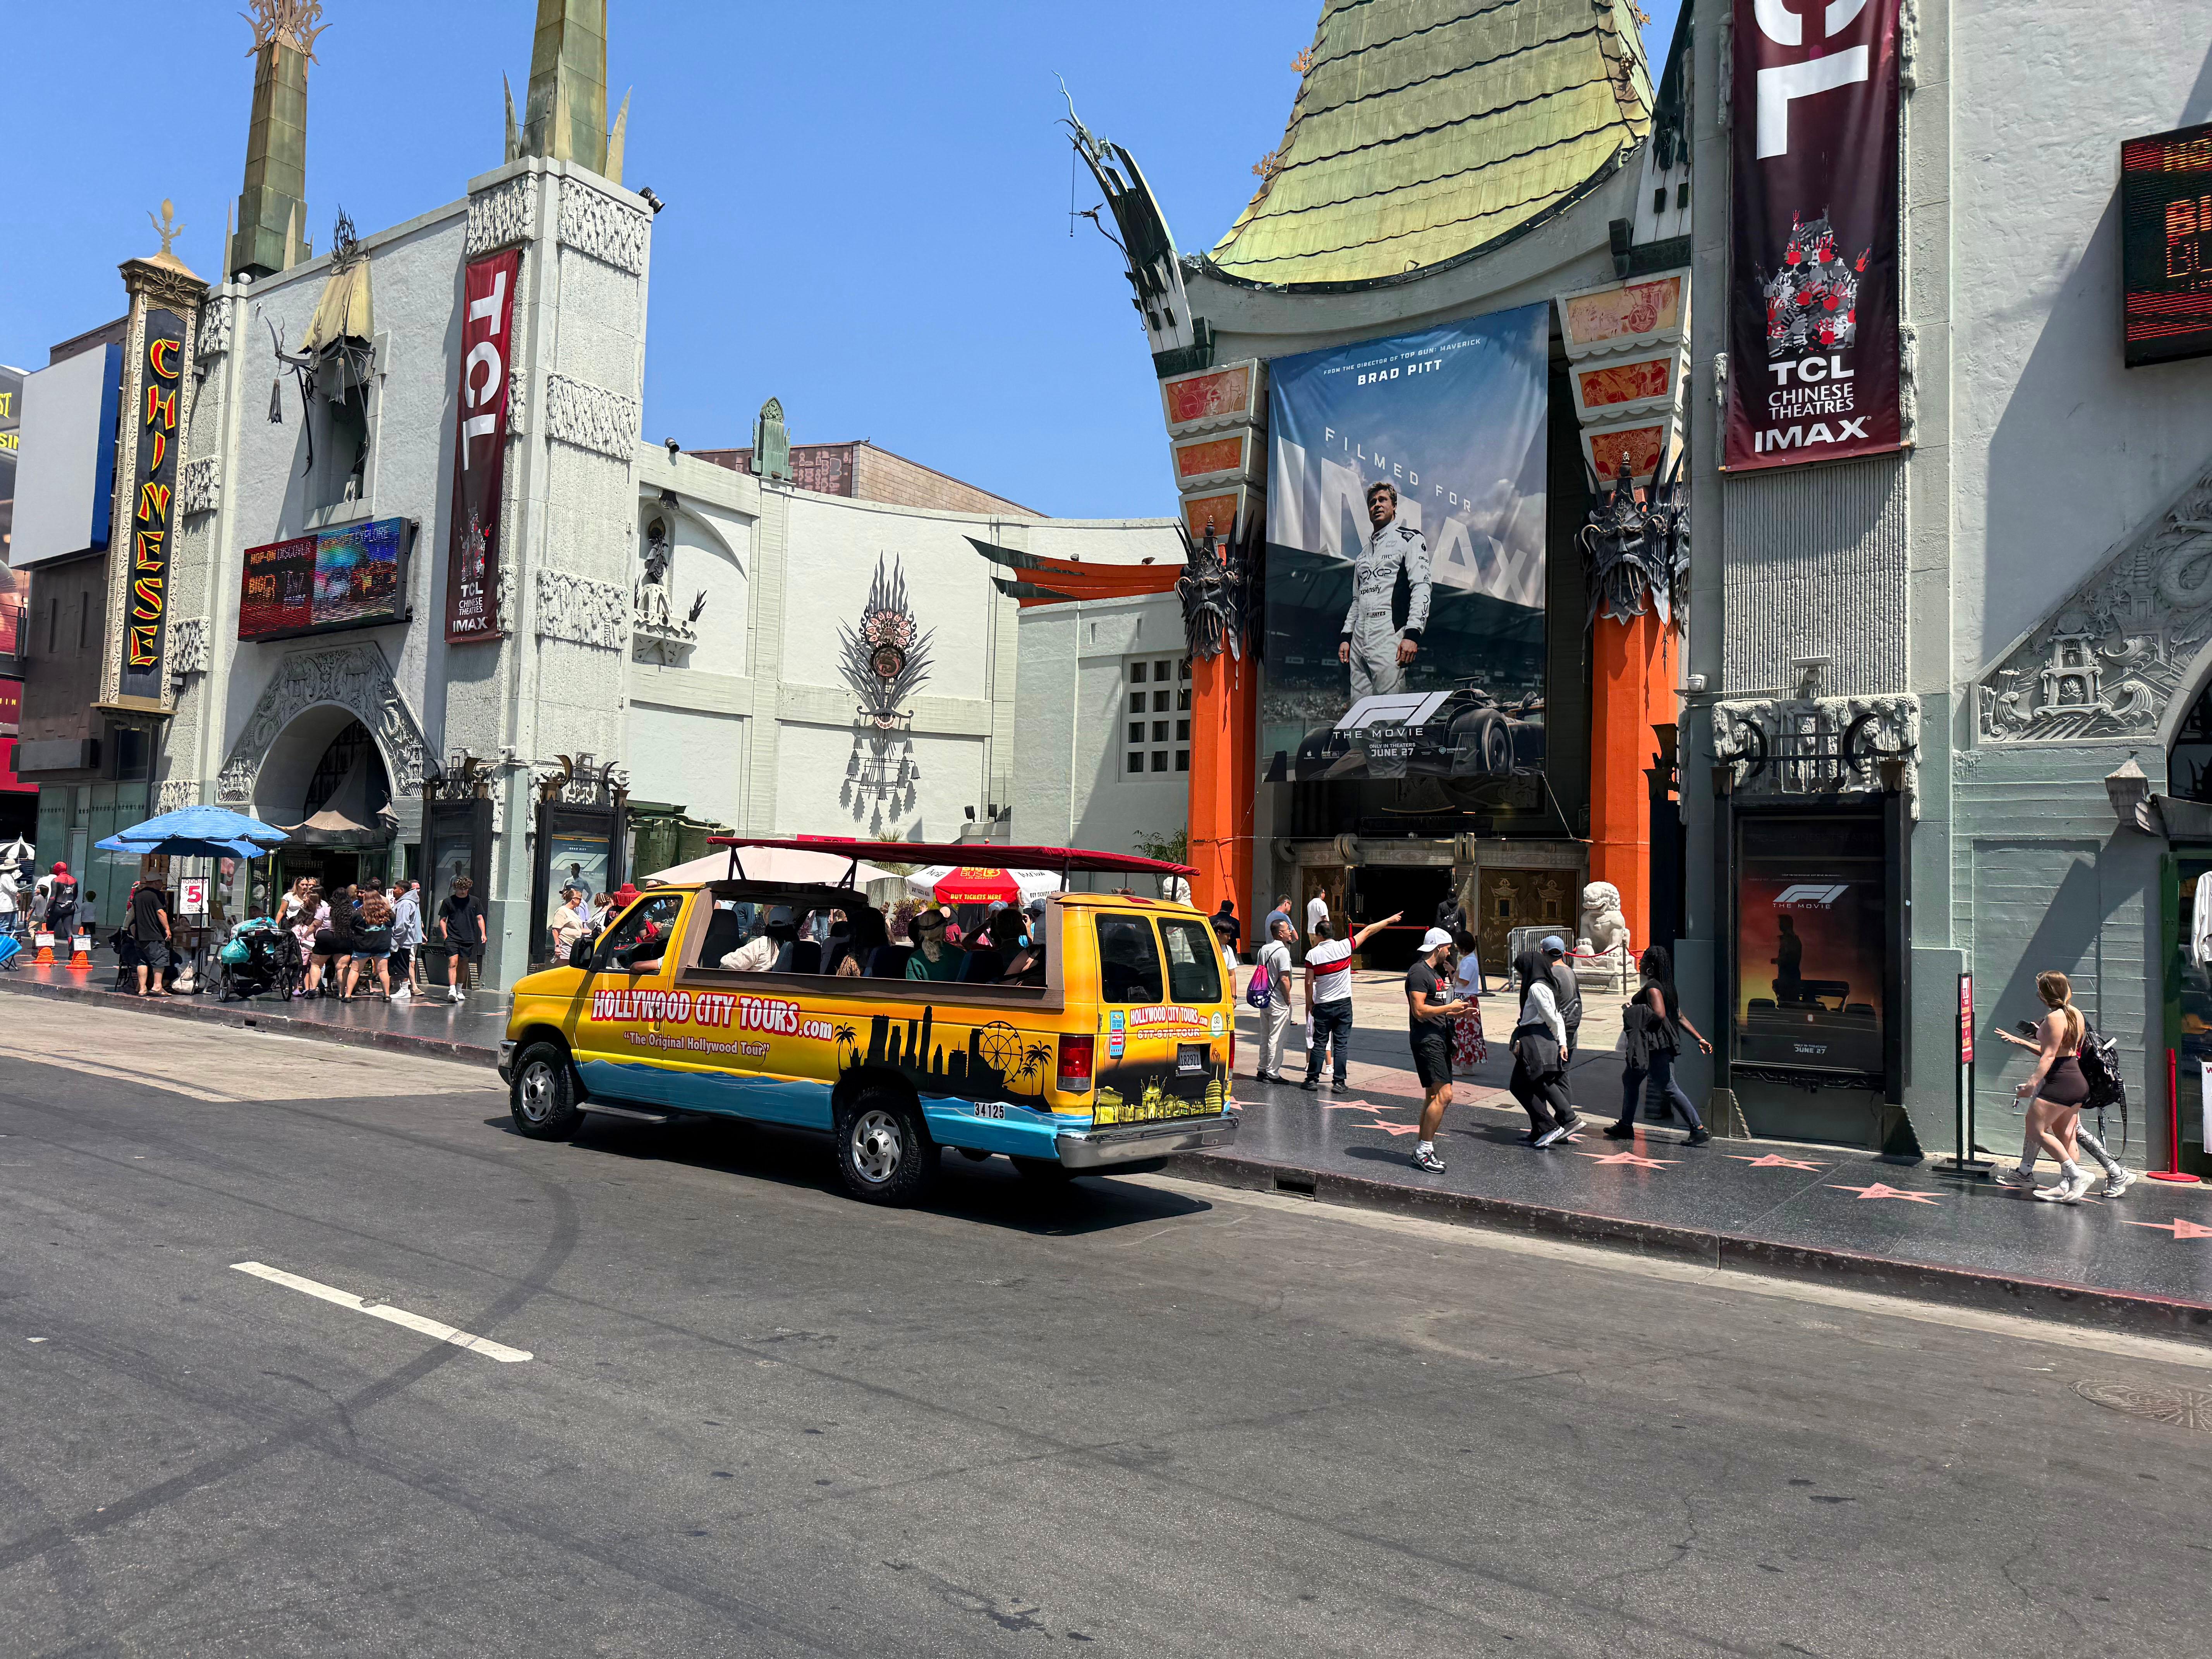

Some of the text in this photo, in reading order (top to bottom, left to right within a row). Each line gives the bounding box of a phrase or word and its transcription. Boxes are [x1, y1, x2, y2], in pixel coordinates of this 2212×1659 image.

[1357, 358, 1387, 369] DIRECTOR
[1400, 351, 1415, 359] TOP
[1418, 347, 1437, 356] GUN:
[1440, 338, 1480, 351] MAVERICK
[462, 270, 507, 471] TCL
[1358, 359, 1442, 386] BRAD PITT
[1768, 355, 1854, 386] TCL
[1768, 382, 1853, 407] CHINESE
[1769, 397, 1854, 421] THEATRES
[1325, 426, 1471, 513] FILMED FOR
[130, 338, 180, 666] CHINESE
[1275, 436, 1529, 605] IMAX
[461, 582, 483, 597] TCL
[459, 597, 483, 608] CHINESE
[459, 606, 483, 615] THEATRES
[1333, 728, 1424, 739] THE MOVIE
[1371, 748, 1398, 757] JUNE
[1401, 748, 1414, 756] 27
[592, 990, 690, 1024] HOLLYWOOD
[696, 993, 735, 1027] CITY
[1130, 1006, 1166, 1027] HOLLYWOOD
[1167, 1006, 1179, 1023] CITY
[649, 1035, 685, 1051] Original
[687, 1037, 737, 1055] Hollywood
[975, 1103, 1005, 1118] 34125
